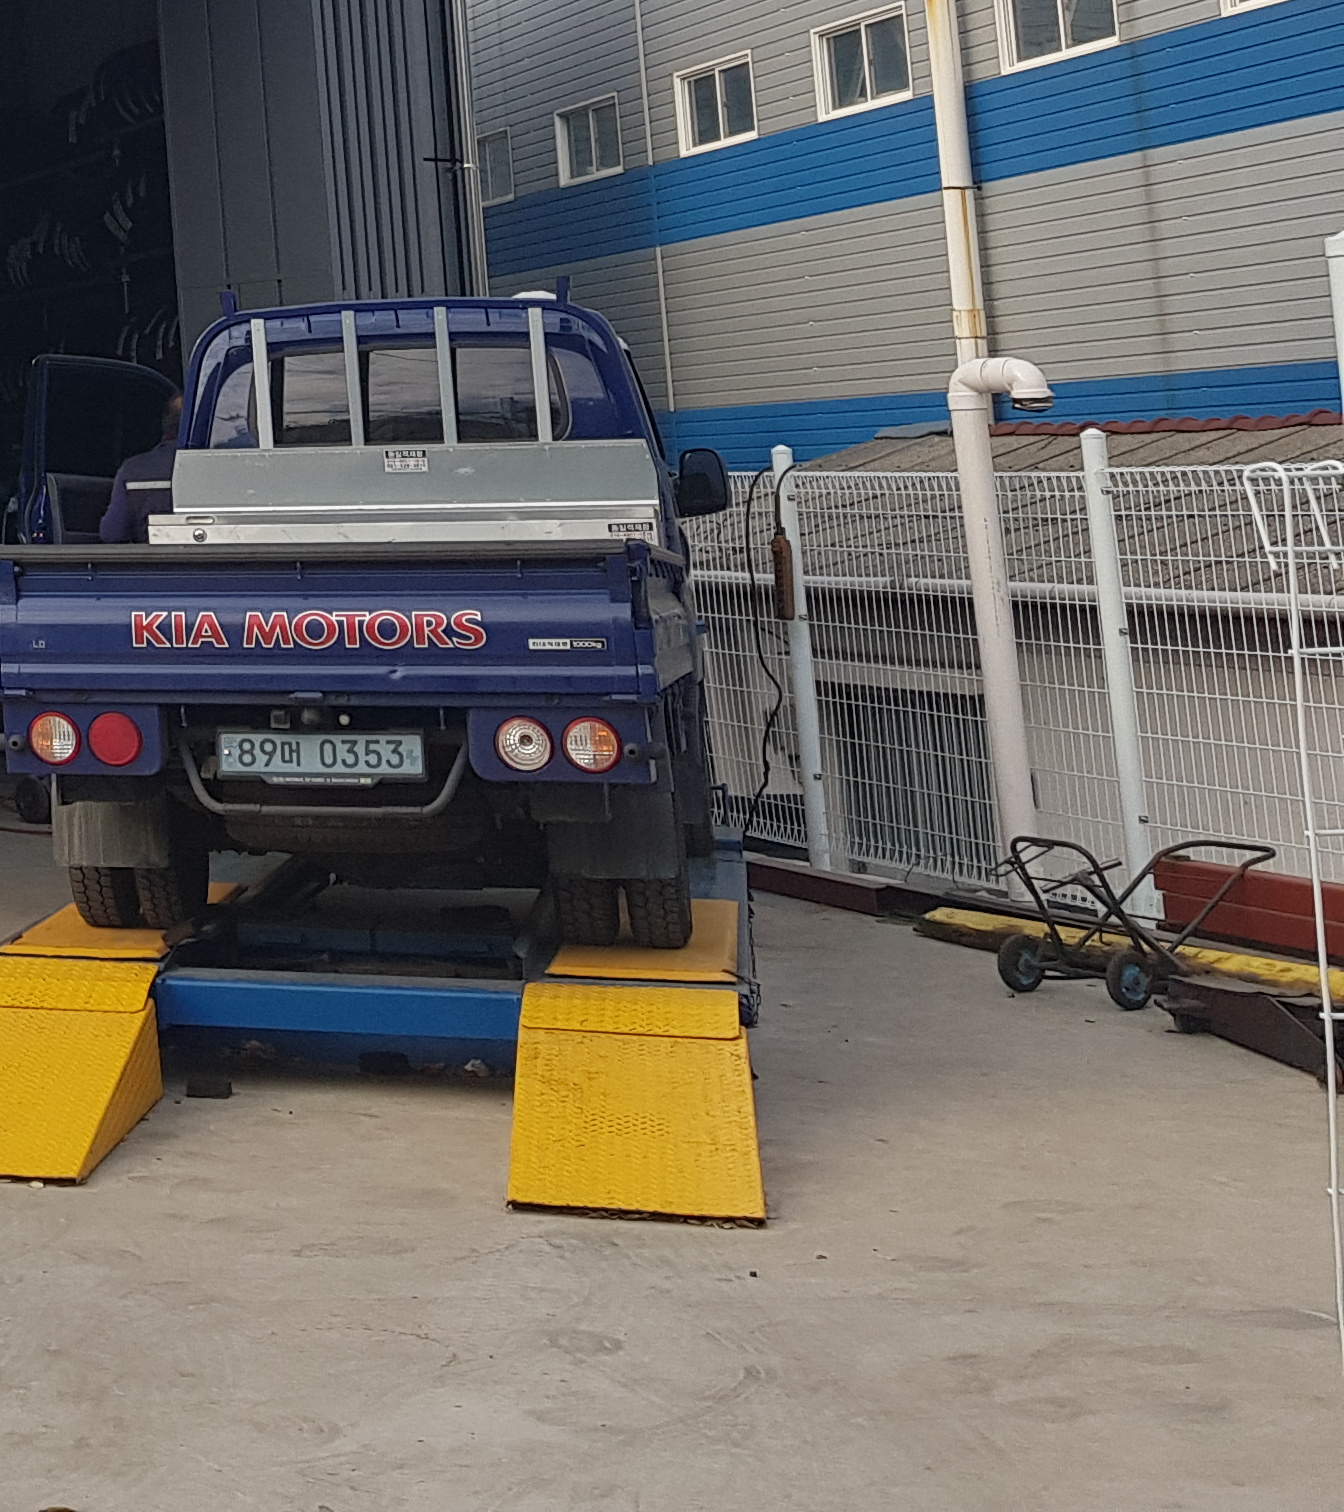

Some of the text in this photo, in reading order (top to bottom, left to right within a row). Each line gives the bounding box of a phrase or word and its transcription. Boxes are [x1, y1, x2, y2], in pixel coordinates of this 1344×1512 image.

[131, 610, 487, 650] KIA MOTORS
[238, 738, 405, 769] 89머 0353
